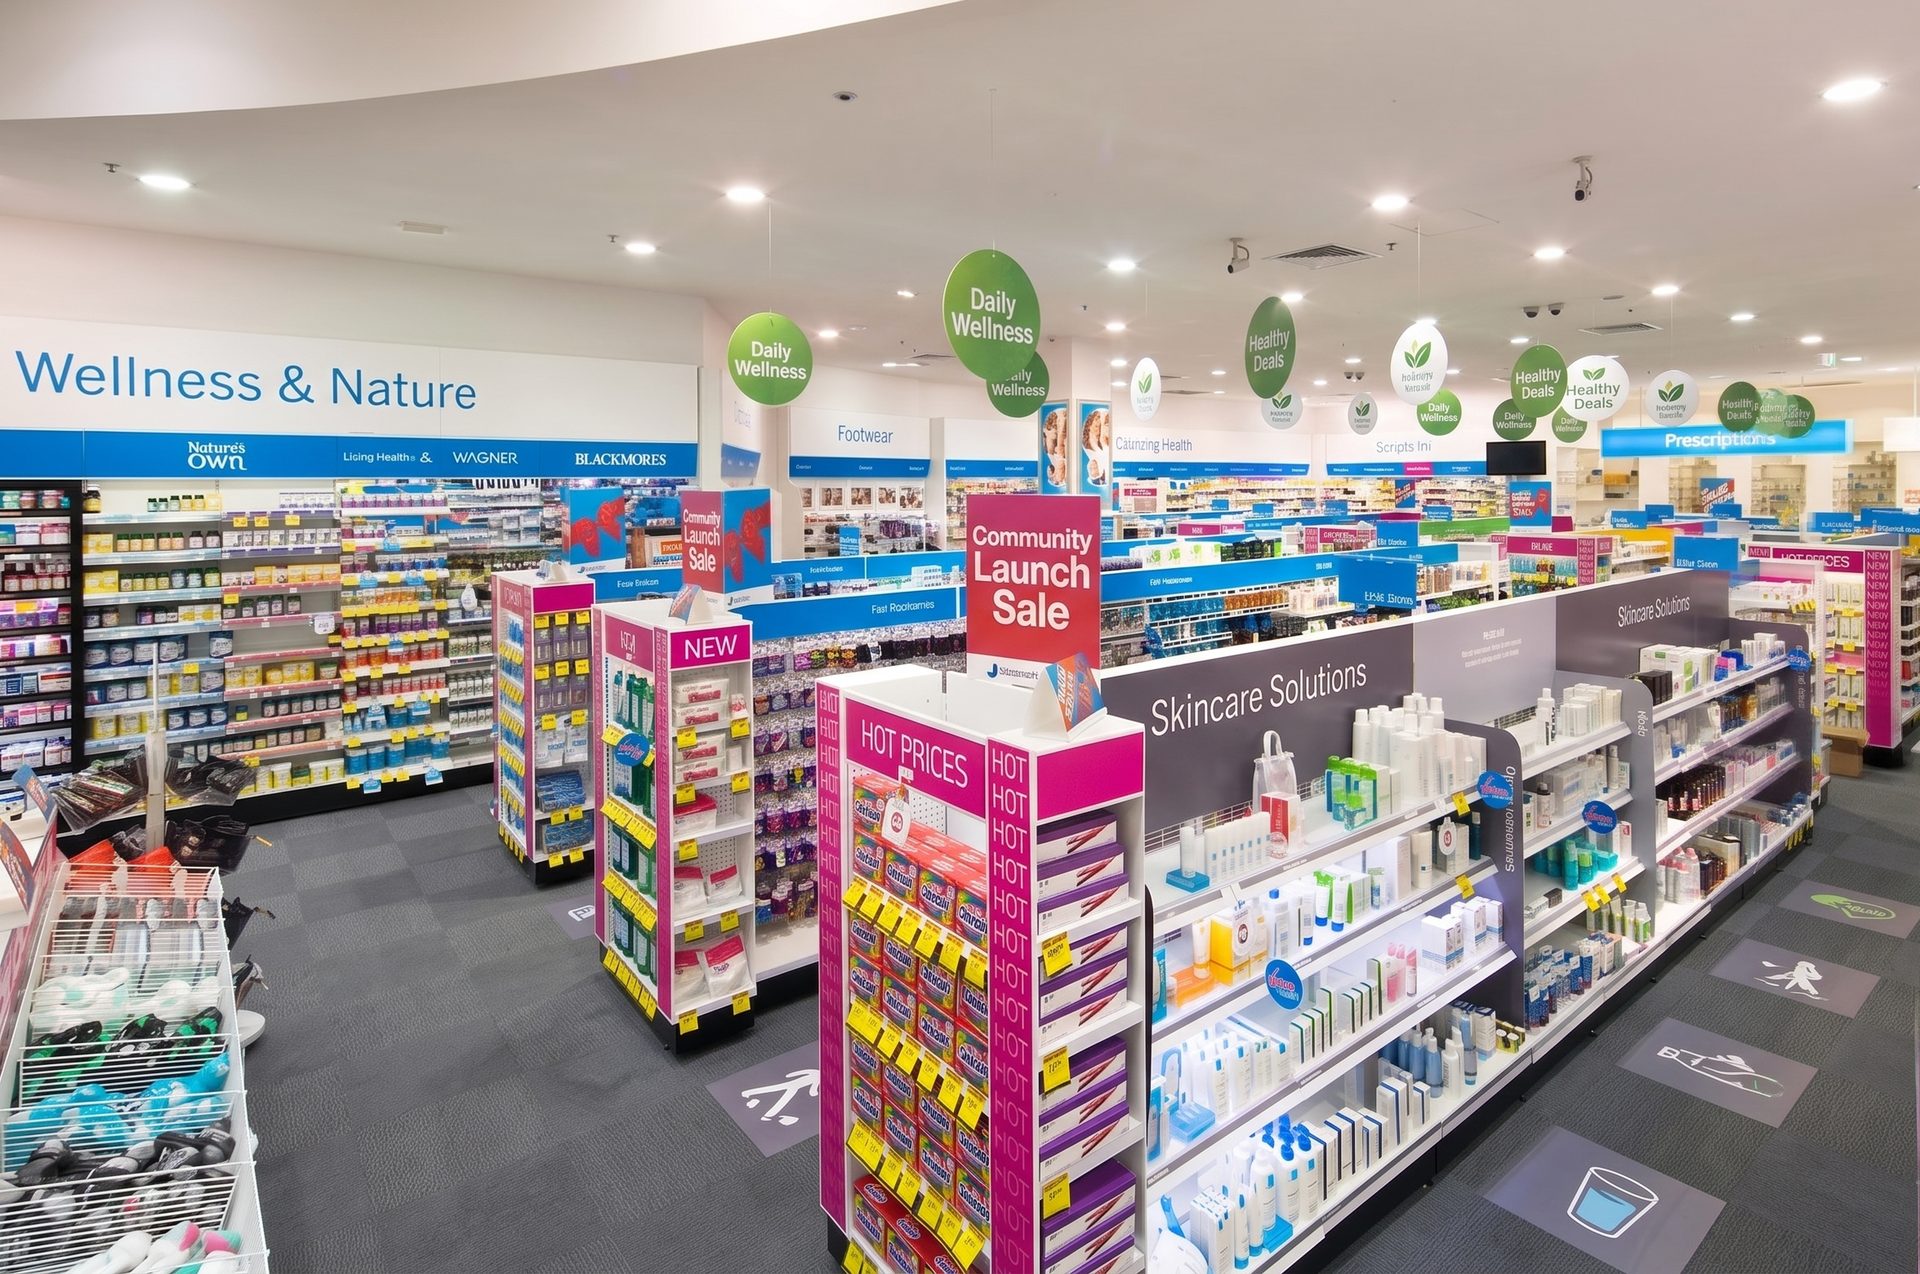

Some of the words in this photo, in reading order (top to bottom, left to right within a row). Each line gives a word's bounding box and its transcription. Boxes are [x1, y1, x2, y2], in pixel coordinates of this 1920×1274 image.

[971, 287, 1016, 319] Daily
[952, 312, 1034, 345] Wellness
[1249, 328, 1290, 353] Healthy
[751, 341, 792, 363] Daily
[1254, 351, 1285, 373] Deals
[15, 350, 262, 401] Wellness
[278, 364, 315, 405] &
[332, 367, 476, 410] Nature
[735, 360, 807, 381] Wellness
[1006, 369, 1031, 385] aily
[1515, 367, 1561, 389] Healthy
[992, 383, 1046, 398] Wellness
[1521, 383, 1555, 401] Deals
[1567, 382, 1620, 400] Healthy
[1574, 397, 1614, 410] Deals
[1420, 413, 1458, 422] Wellness
[1428, 402, 1450, 414] Daily
[838, 424, 894, 443] Footwear
[1162, 438, 1192, 451] Health
[187, 441, 246, 454] Nature's
[420, 451, 433, 463] &
[453, 451, 518, 465] WAGNER
[575, 452, 667, 467] BLACKMORES
[1376, 441, 1414, 454] Scripts
[683, 508, 721, 530] Community
[684, 525, 720, 547] Launch
[972, 524, 1093, 556] Community
[688, 546, 717, 573] Sale
[974, 550, 1091, 589] Launch
[1866, 551, 1889, 561] NEW
[992, 588, 1070, 631] Sale
[1618, 602, 1654, 628] Skincare
[1655, 595, 1690, 617] Solutions
[684, 633, 738, 661] NEW
[1151, 685, 1263, 737] Skincare
[1270, 663, 1367, 708] Solutions
[861, 718, 897, 760] HOT
[901, 734, 969, 789] PRICES
[992, 748, 1028, 783] HOT
[992, 783, 1028, 818] HOT
[992, 817, 1028, 853] HOT
[992, 851, 1028, 889] HOT
[992, 885, 1028, 924] HOT
[992, 920, 1028, 960] HOT
[992, 954, 1028, 994] HOT
[992, 988, 1028, 1028] HOT
[994, 1022, 1028, 1064] HOT
[994, 1056, 1028, 1100] HOT
[994, 1089, 1028, 1134] HOT
[994, 1124, 1028, 1169] HOT
